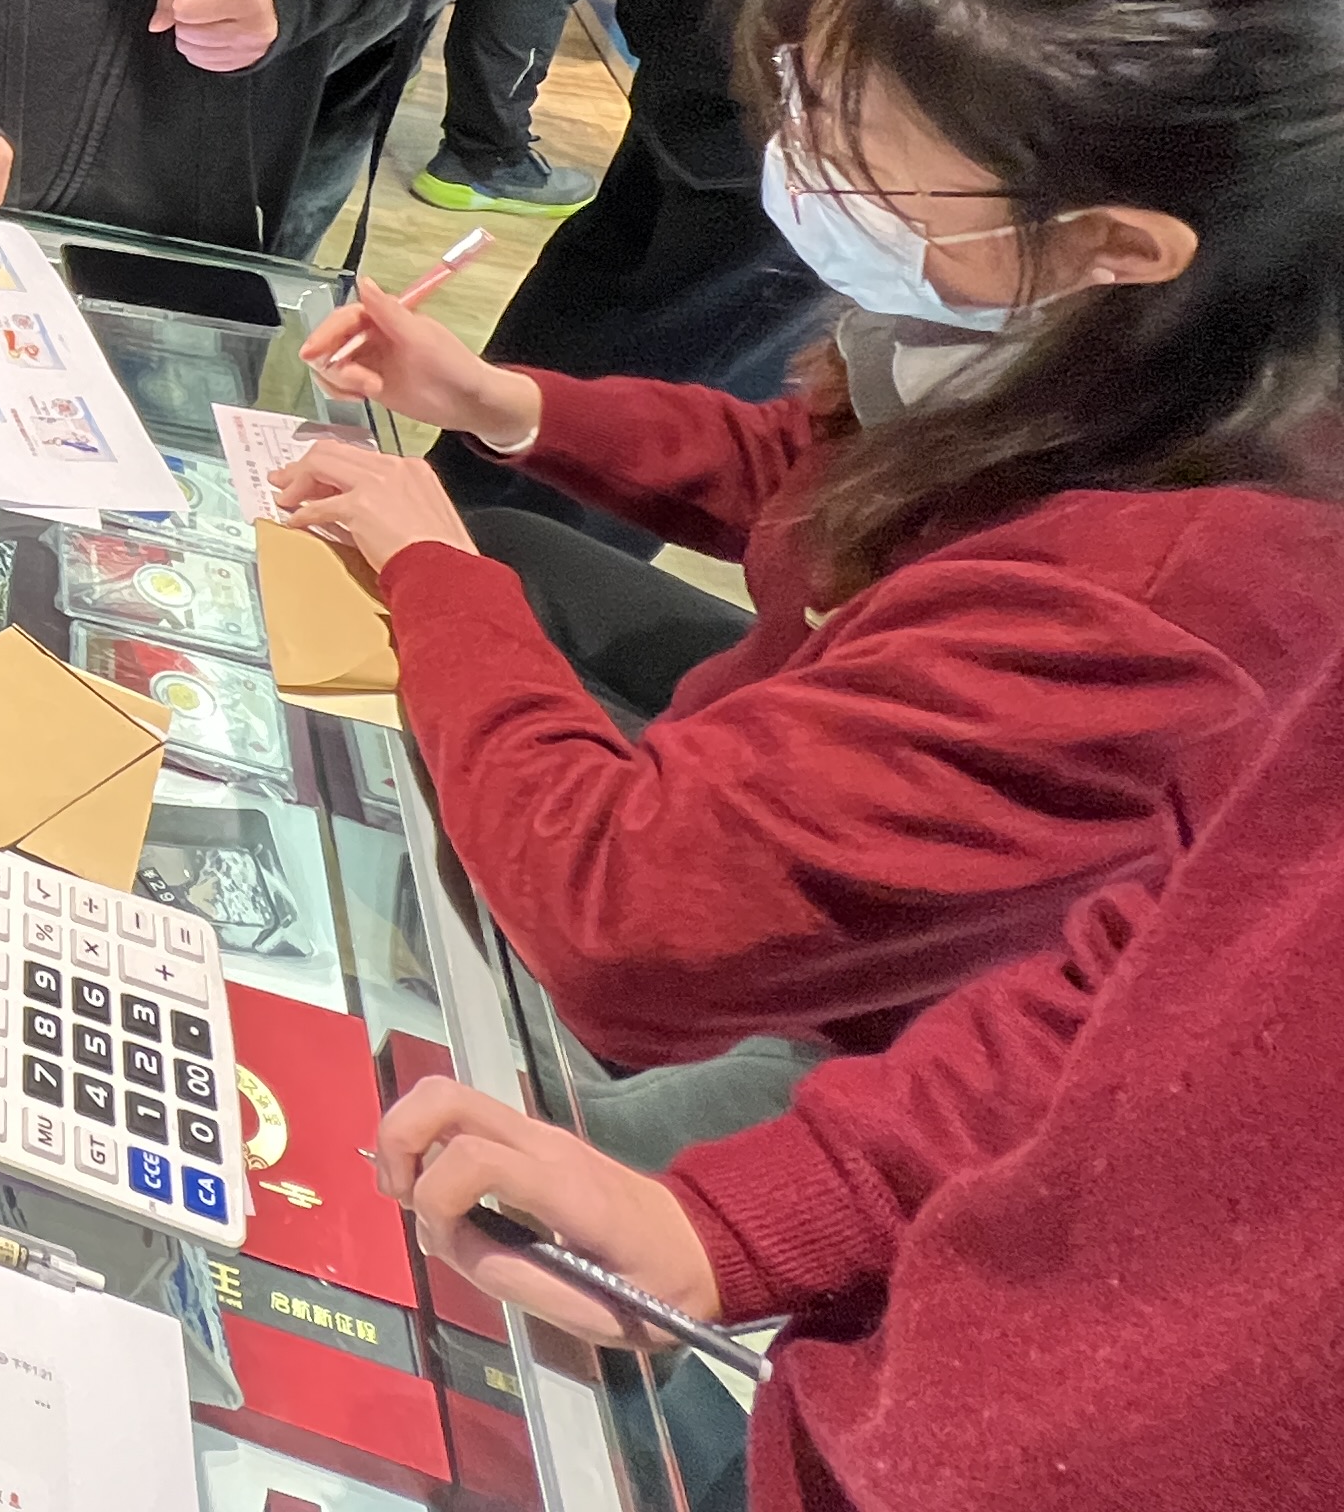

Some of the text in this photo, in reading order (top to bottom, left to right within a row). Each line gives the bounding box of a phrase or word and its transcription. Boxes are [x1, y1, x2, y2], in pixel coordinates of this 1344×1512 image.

[35, 972, 57, 991] 9
[134, 1005, 155, 1025] 3
[35, 1017, 57, 1038] 8
[136, 1055, 158, 1073] 2
[34, 1065, 58, 1086] 7
[85, 986, 110, 1165] GT 4 5 6
[139, 1106, 160, 1119] 1
[37, 1116, 53, 1146] MU
[187, 1065, 218, 1206] CA 0 00
[269, 1292, 378, 1345] 启航新征程
